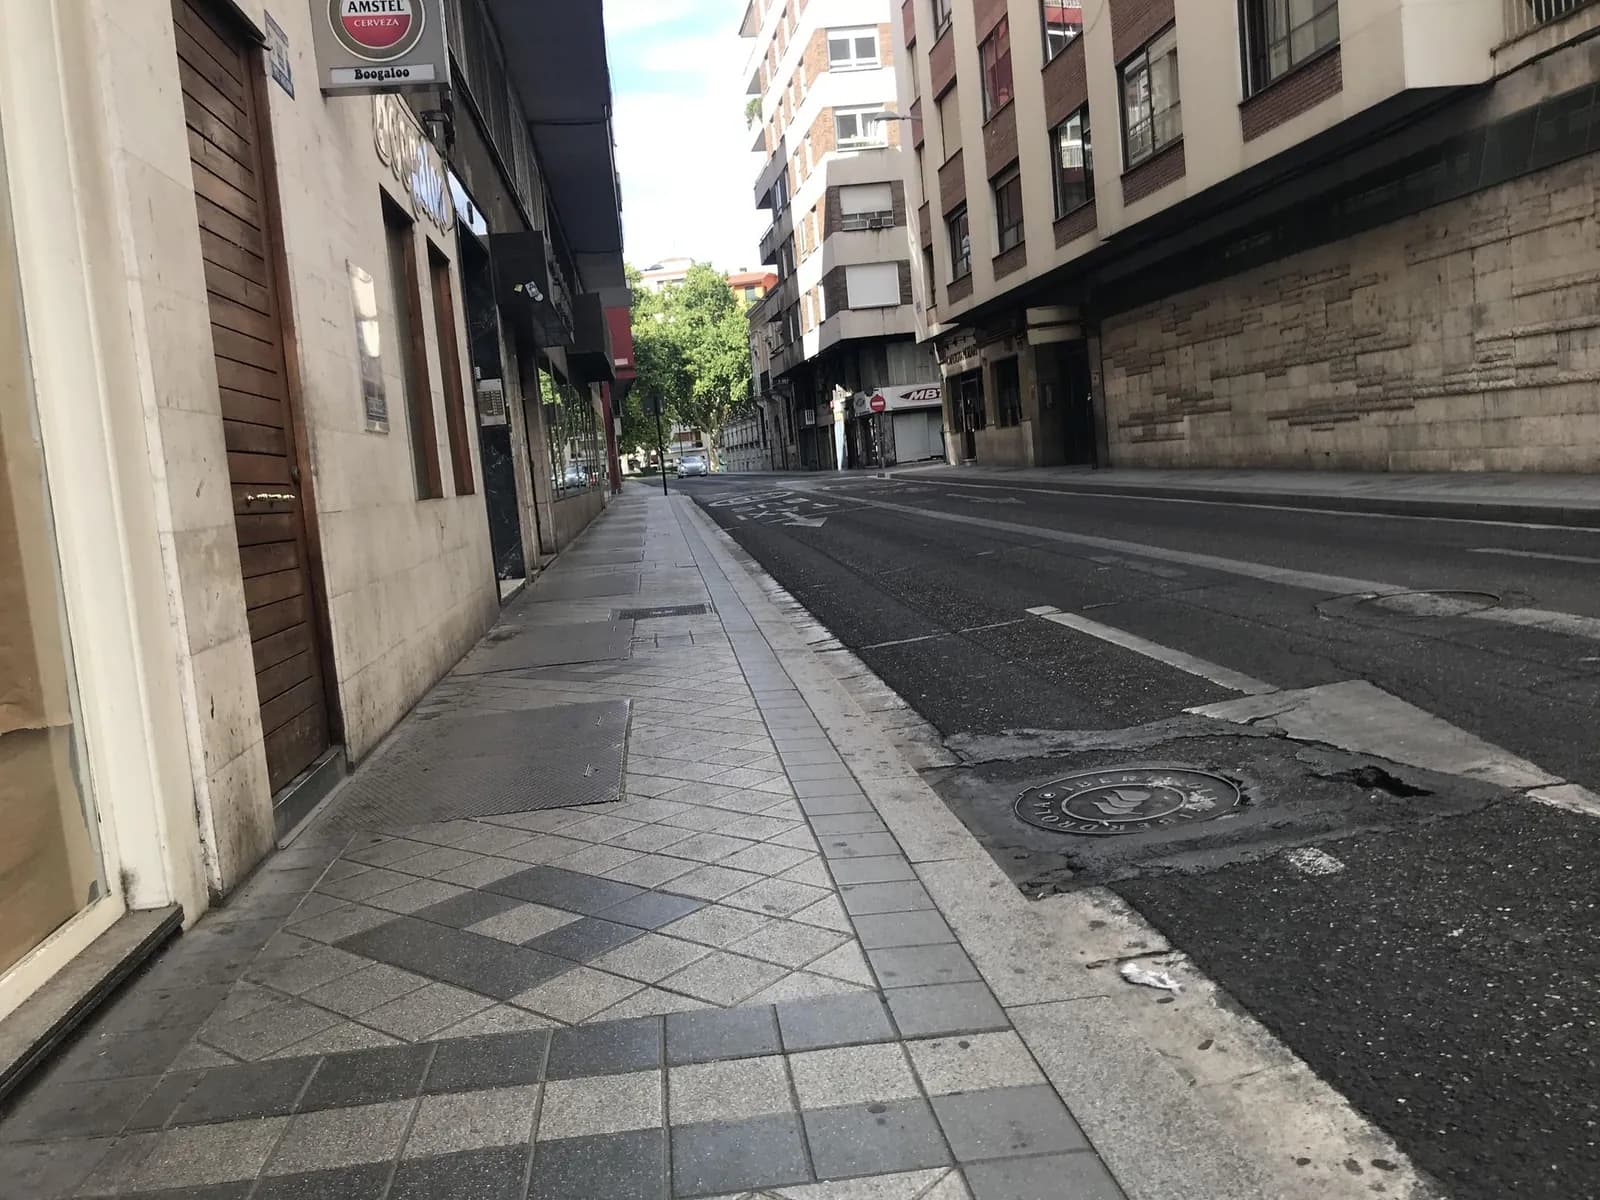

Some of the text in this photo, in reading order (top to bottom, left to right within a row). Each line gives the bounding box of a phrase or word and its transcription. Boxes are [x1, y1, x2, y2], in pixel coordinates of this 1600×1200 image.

[348, 0, 405, 13] AMSTEL
[353, 18, 400, 28] CERVEZA
[354, 67, 410, 81] Boogaloo
